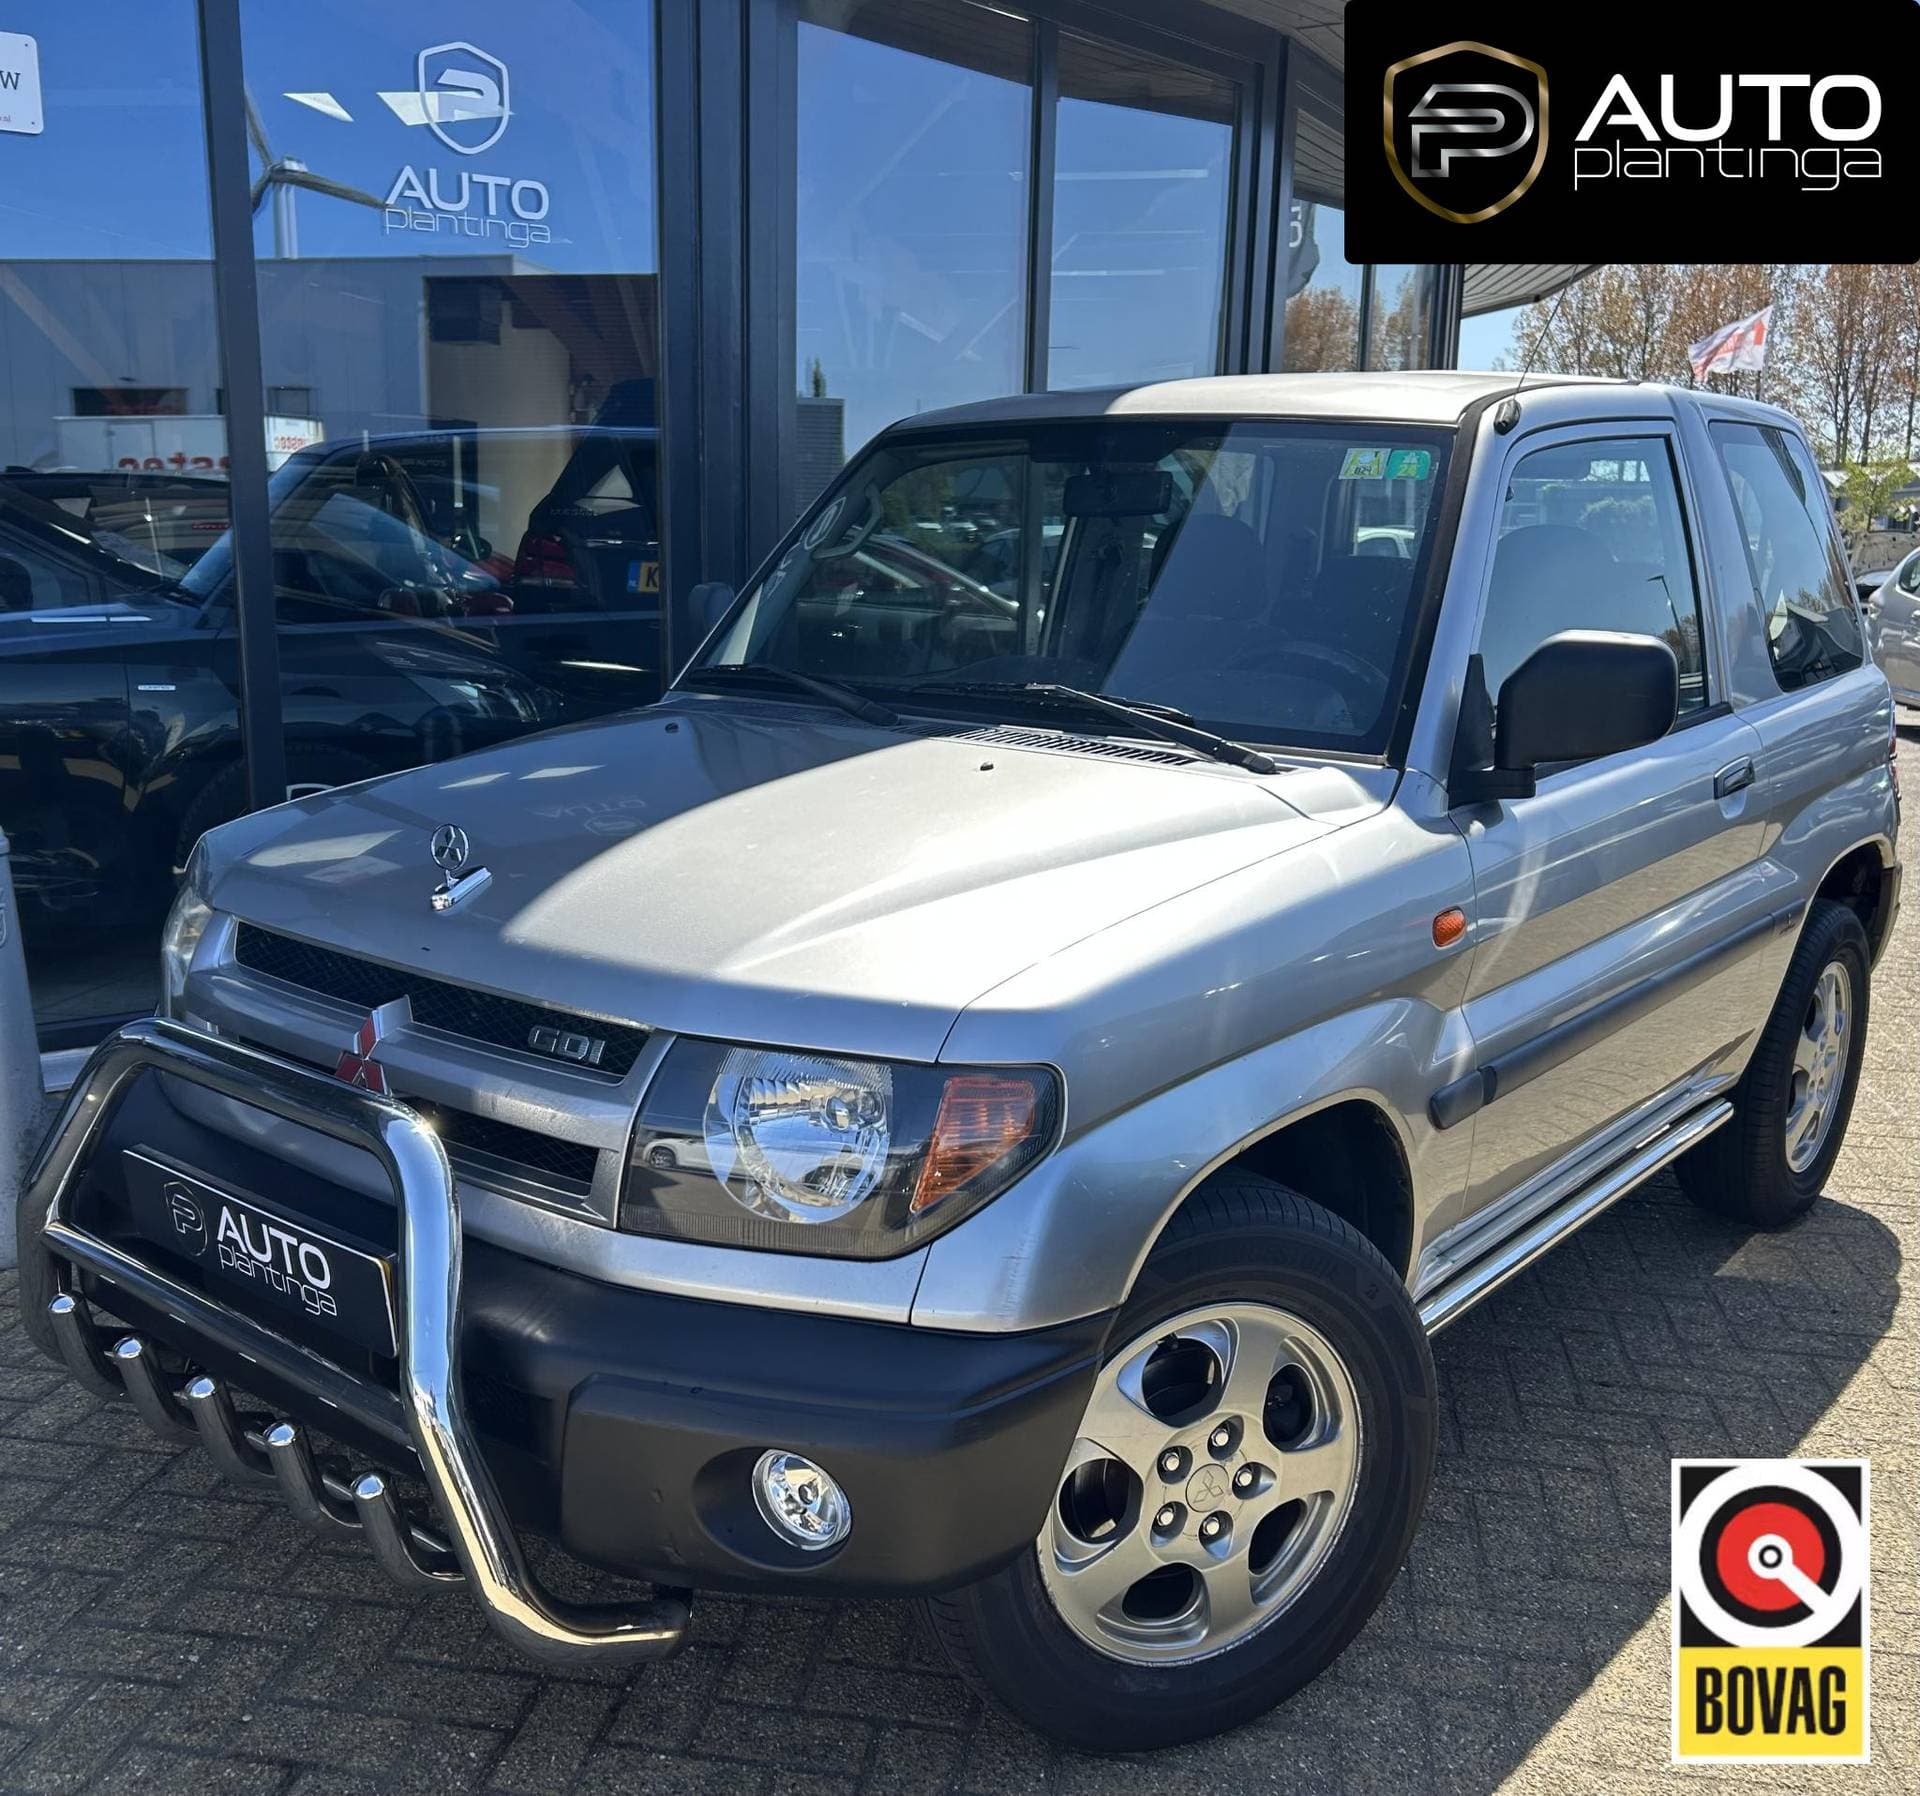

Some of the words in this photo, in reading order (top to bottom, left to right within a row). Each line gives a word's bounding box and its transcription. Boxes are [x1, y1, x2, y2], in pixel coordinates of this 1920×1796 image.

[385, 165, 550, 220] AUTO
[385, 205, 551, 248] plantinga
[528, 1024, 606, 1065] GDI
[217, 1205, 331, 1289] AUTO
[217, 1244, 338, 1316] plantinga
